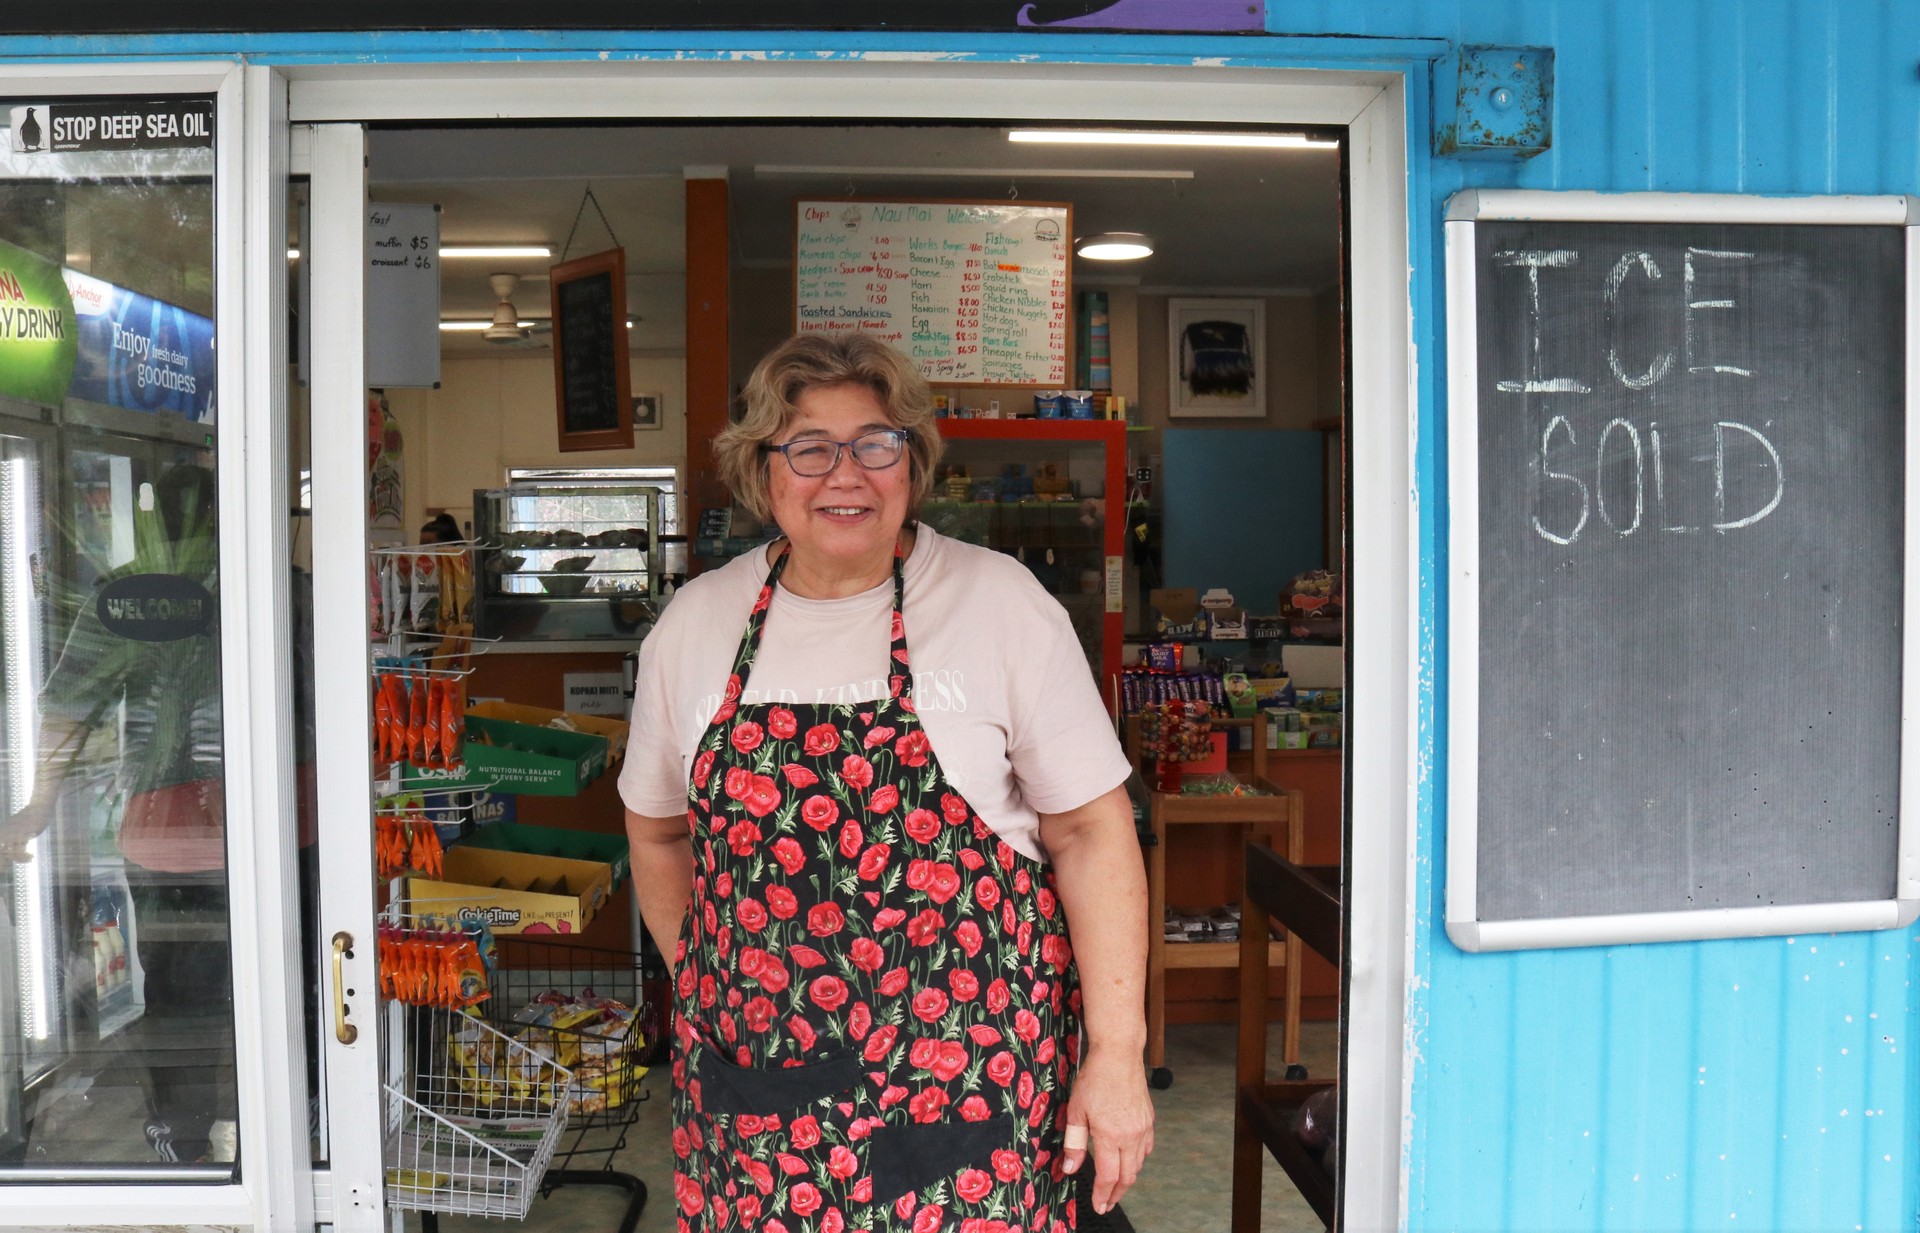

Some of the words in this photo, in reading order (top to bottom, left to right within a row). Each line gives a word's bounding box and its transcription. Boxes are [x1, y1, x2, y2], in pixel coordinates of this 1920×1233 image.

[53, 116, 96, 141] STOP
[101, 114, 143, 140] DEEP
[146, 113, 179, 138] SEA
[183, 112, 209, 137] OIL
[908, 206, 932, 222] Mai
[947, 208, 1000, 224] Welcome
[375, 236, 402, 248] muffin
[410, 235, 429, 251] $5
[909, 236, 938, 250] Works
[985, 232, 1003, 245] Fish
[371, 256, 409, 266] croissant
[414, 255, 431, 269] $6
[940, 256, 955, 269] Egg
[909, 267, 941, 278] Cheese
[982, 271, 1021, 284] Crabstick
[911, 280, 932, 289] Ham
[982, 282, 1006, 296] Squid
[1009, 287, 1028, 298] ring
[76, 284, 103, 304] Anchor
[911, 291, 930, 302] Fish
[982, 293, 1016, 305] Chicken
[1017, 297, 1047, 307] Nibbles
[798, 304, 835, 318] Toasted
[839, 305, 892, 318] Sandwiches
[911, 303, 949, 313] Hawaiian
[982, 303, 1014, 314] Chicken
[1017, 308, 1048, 321] Nuggets
[17, 308, 65, 339] DRINK
[912, 316, 929, 334] Egg
[982, 313, 998, 322] Hot
[1000, 315, 1019, 329] dogs
[1491, 246, 1758, 393] ICE
[982, 323, 1011, 338] Spring
[1012, 328, 1028, 337] roll
[113, 322, 151, 360] Enjoy
[152, 345, 171, 363] fresh
[170, 349, 189, 369] dairy
[912, 345, 951, 357] Chicken
[982, 345, 1022, 361] Pineapple
[918, 364, 933, 378] Veg
[936, 363, 954, 376] Spring
[982, 358, 1023, 371] Sausages
[137, 363, 196, 394] goodness
[982, 367, 1005, 378] Prawn
[1532, 414, 1784, 545] SOLD
[570, 686, 598, 695] KOPAKI
[580, 701, 601, 710] pies
[479, 766, 526, 774] NUTRITIONAL
[528, 768, 562, 776] BALANCE
